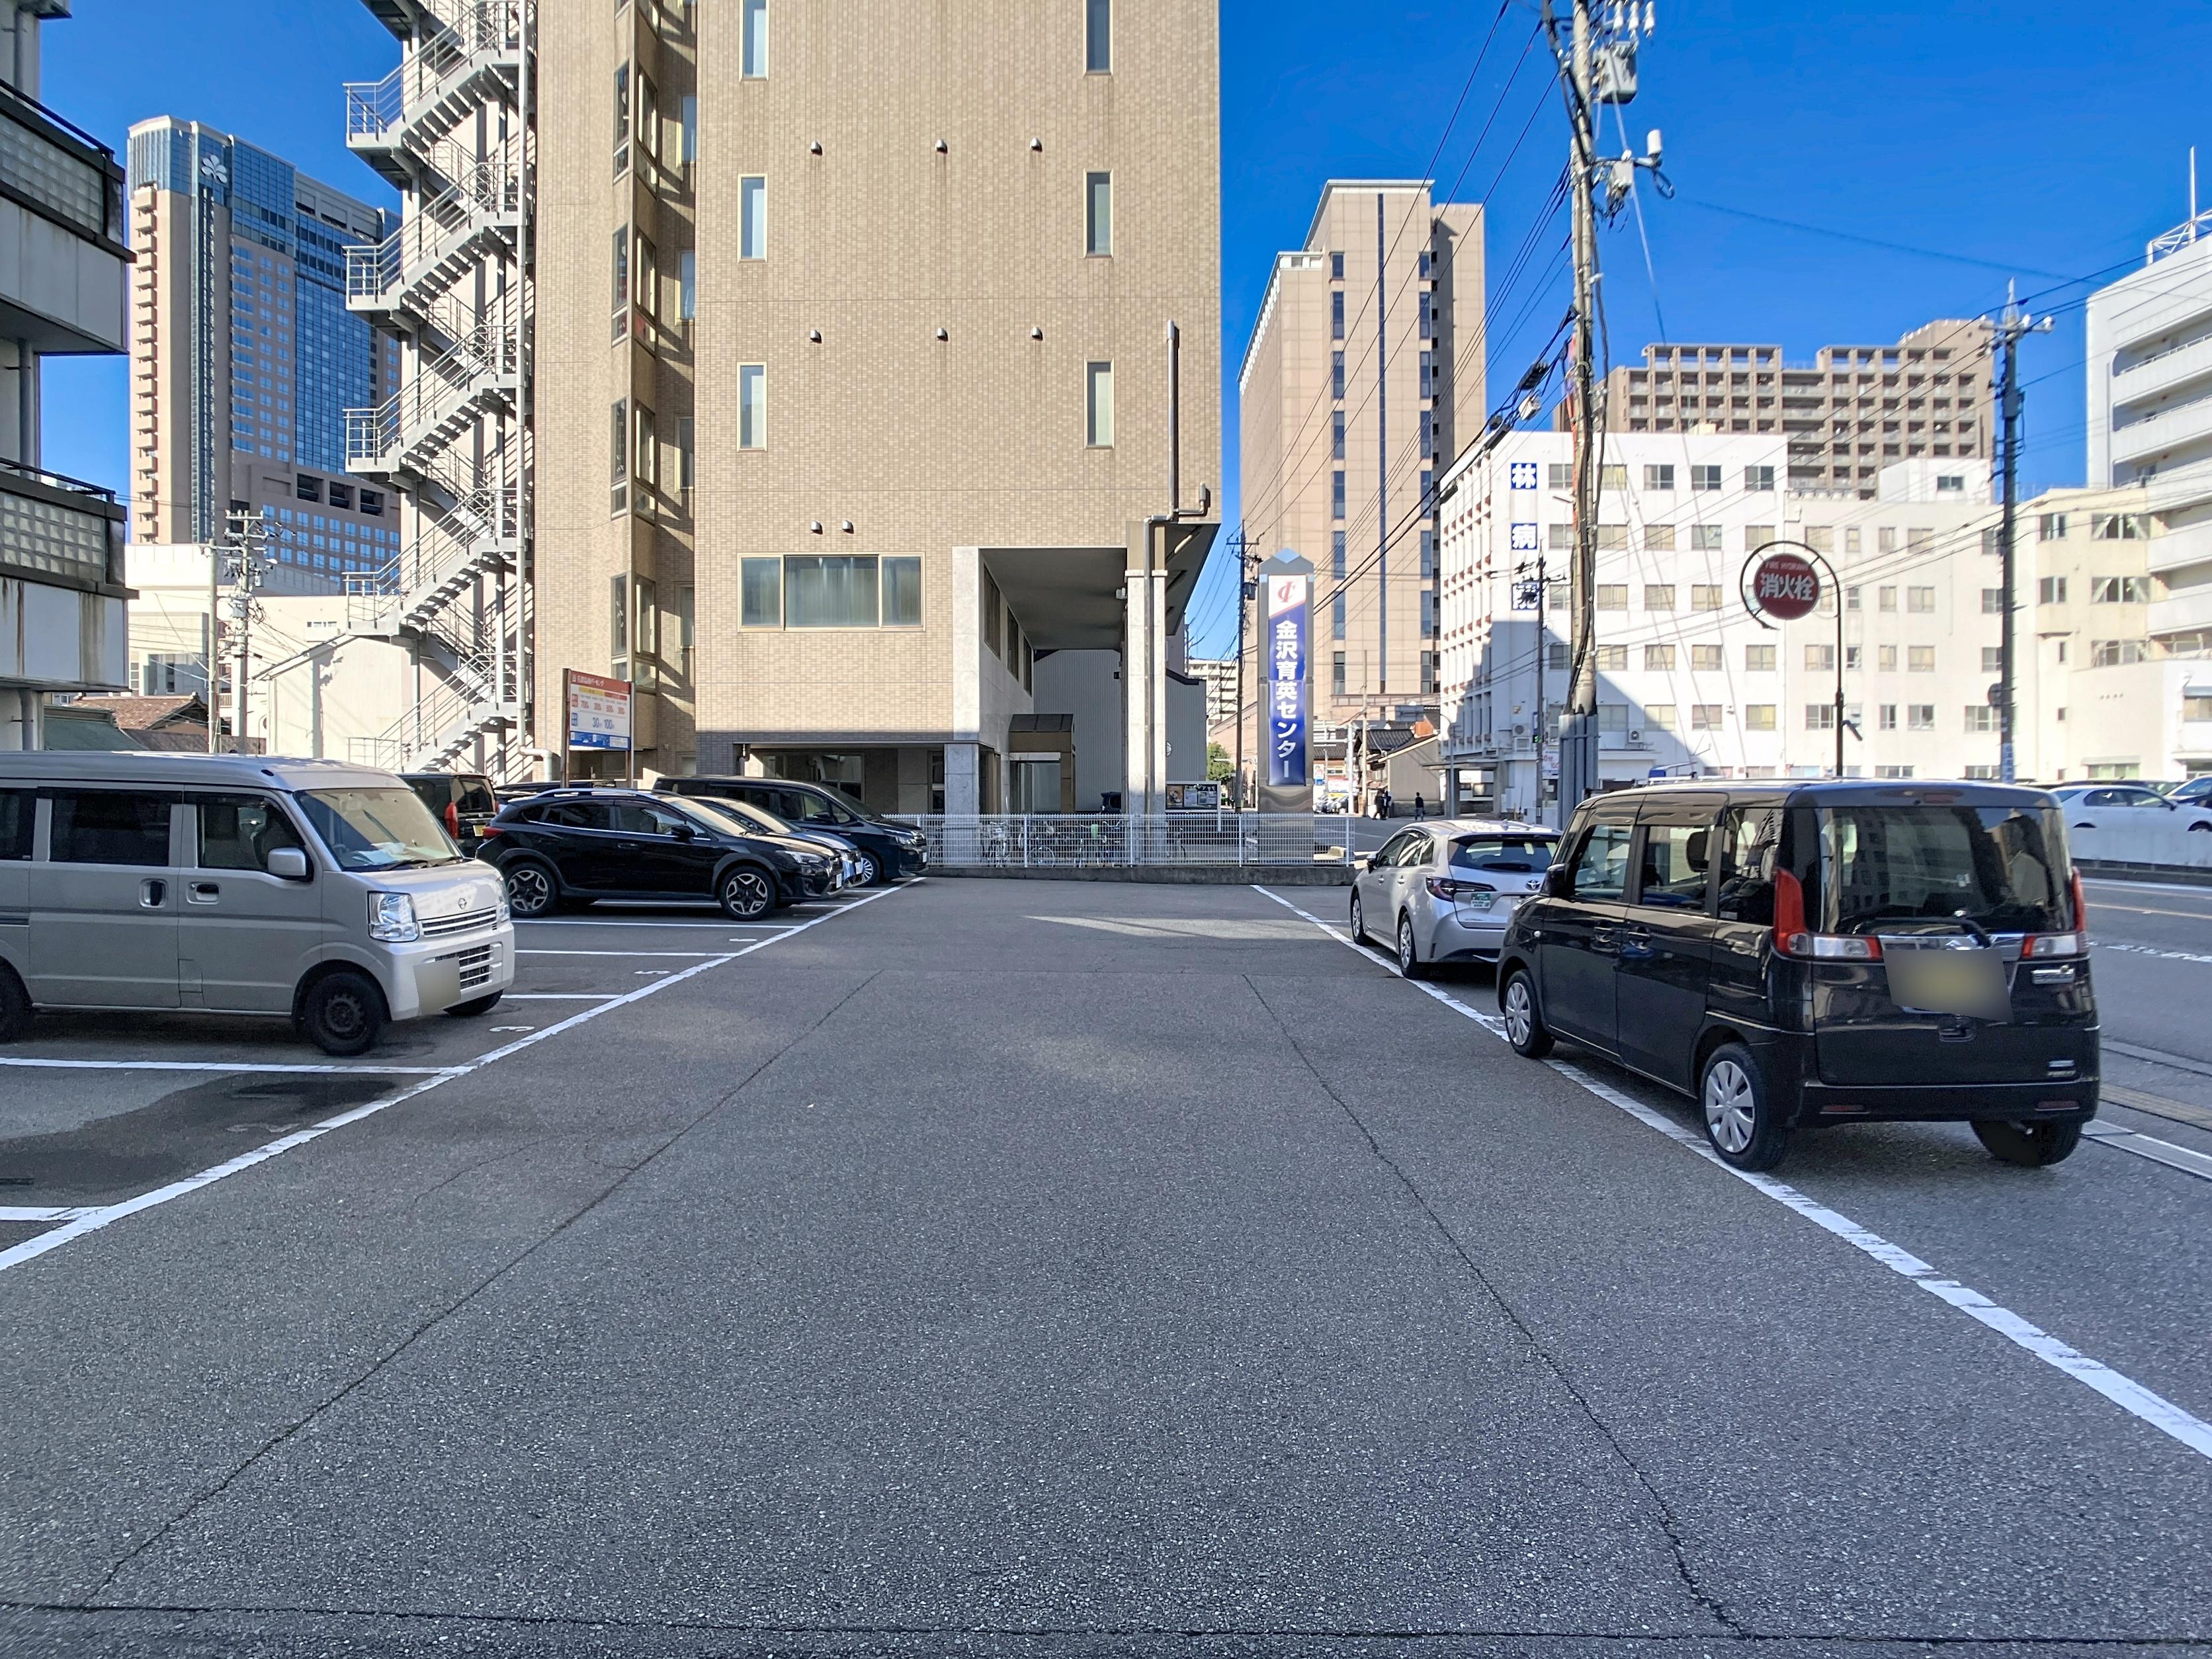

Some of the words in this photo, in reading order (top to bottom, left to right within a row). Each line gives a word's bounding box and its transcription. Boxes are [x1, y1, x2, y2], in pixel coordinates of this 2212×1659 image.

[1760, 572, 1814, 601] 消火栓
[1275, 620, 1298, 778] 金沢育英センター
